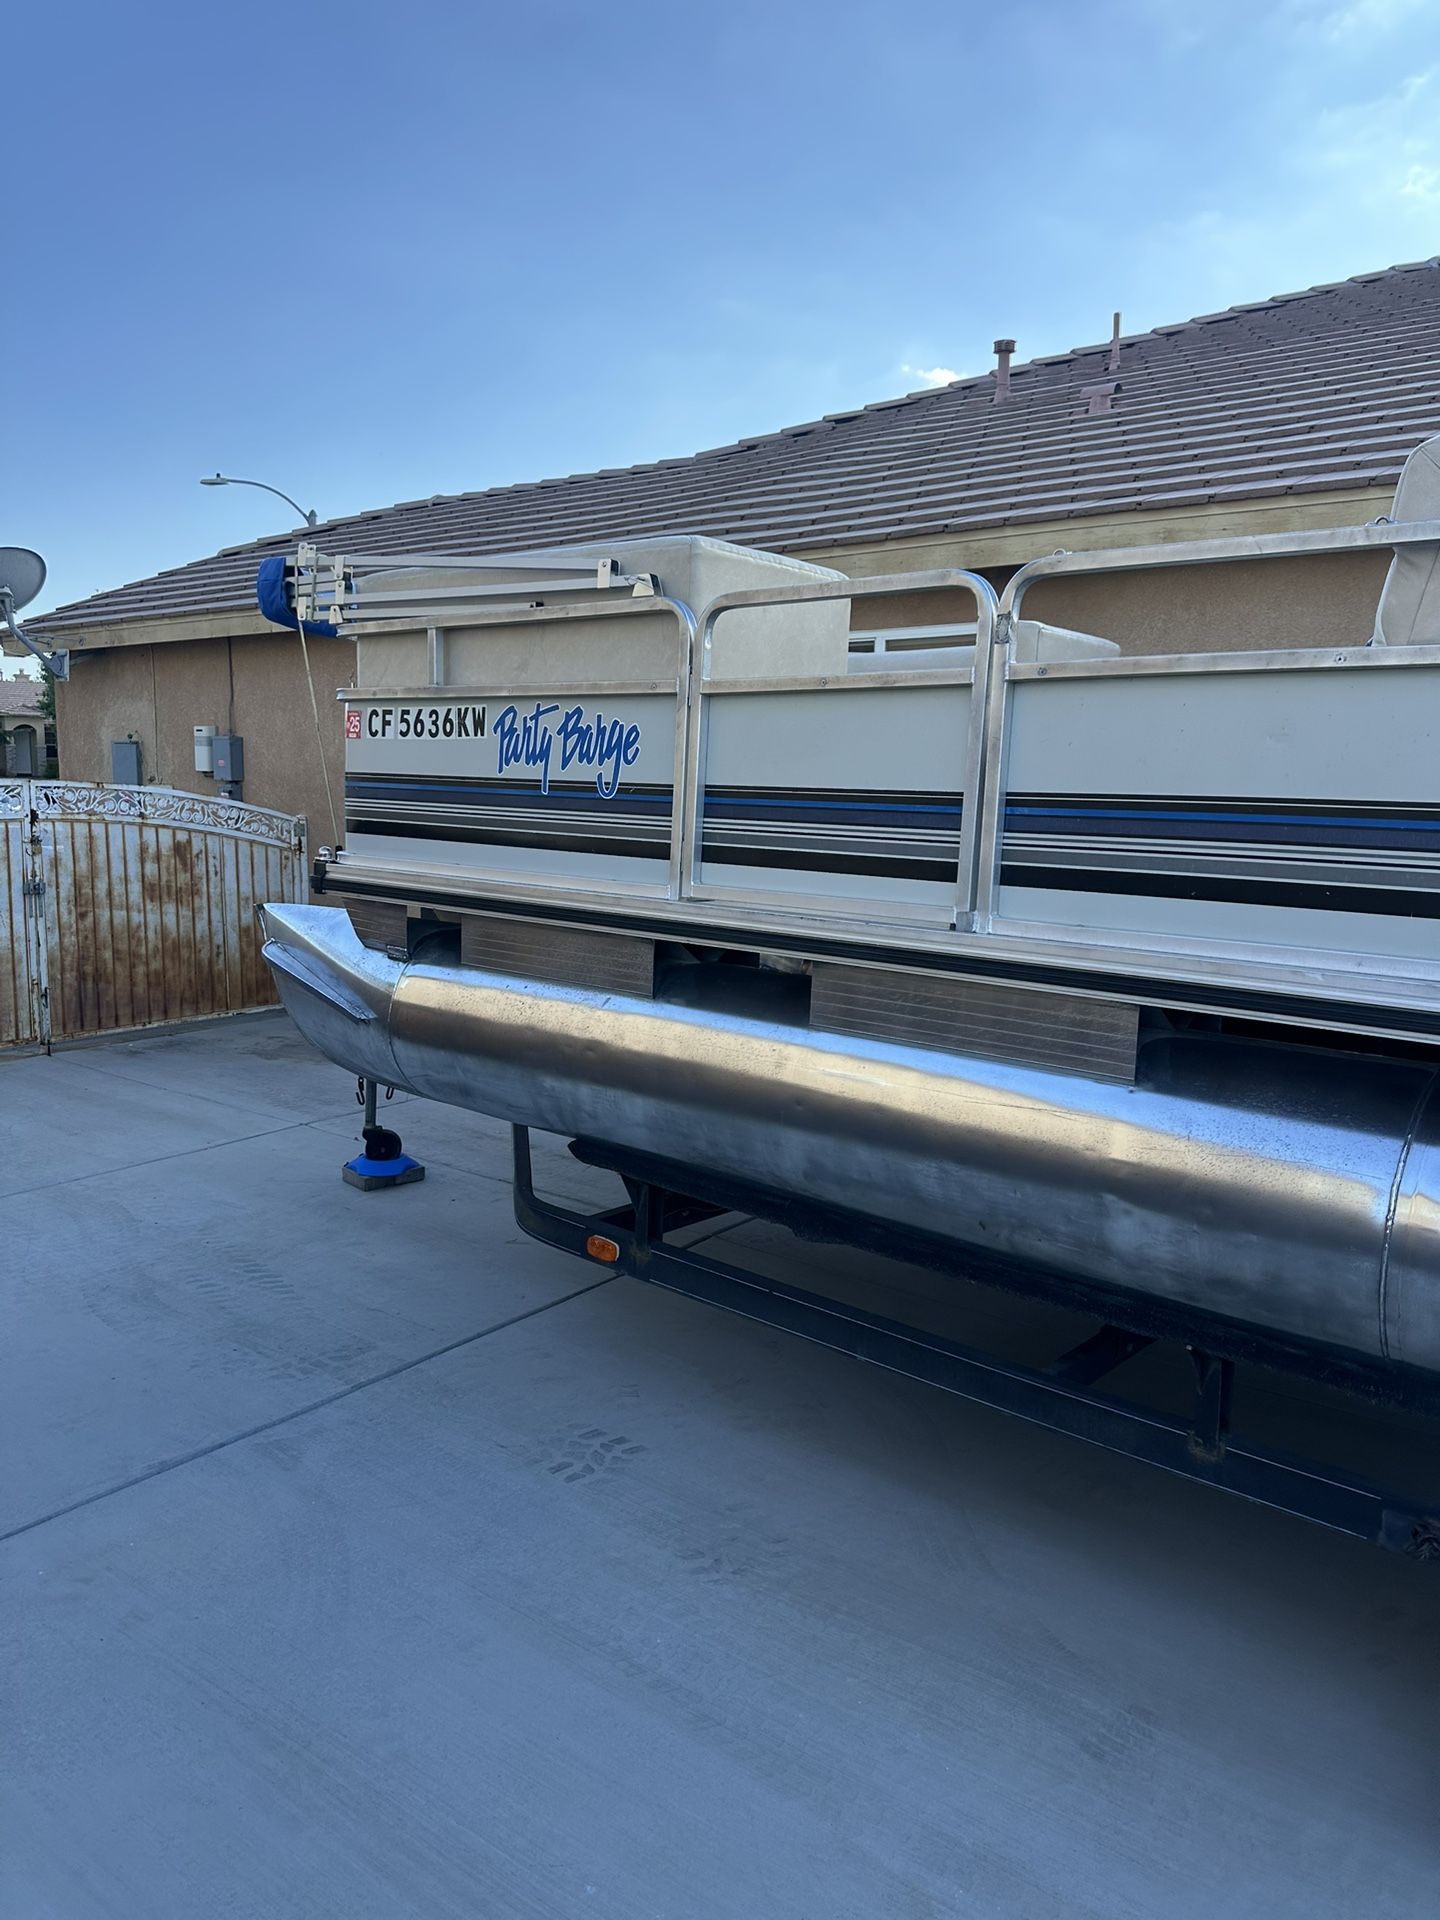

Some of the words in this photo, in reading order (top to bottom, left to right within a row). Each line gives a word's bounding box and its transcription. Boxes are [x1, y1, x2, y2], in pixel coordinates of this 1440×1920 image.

[350, 716, 360, 732] 25
[368, 708, 393, 738] CF
[399, 706, 486, 738] 5636KW
[492, 702, 560, 794] Party
[556, 705, 640, 799] Barge
